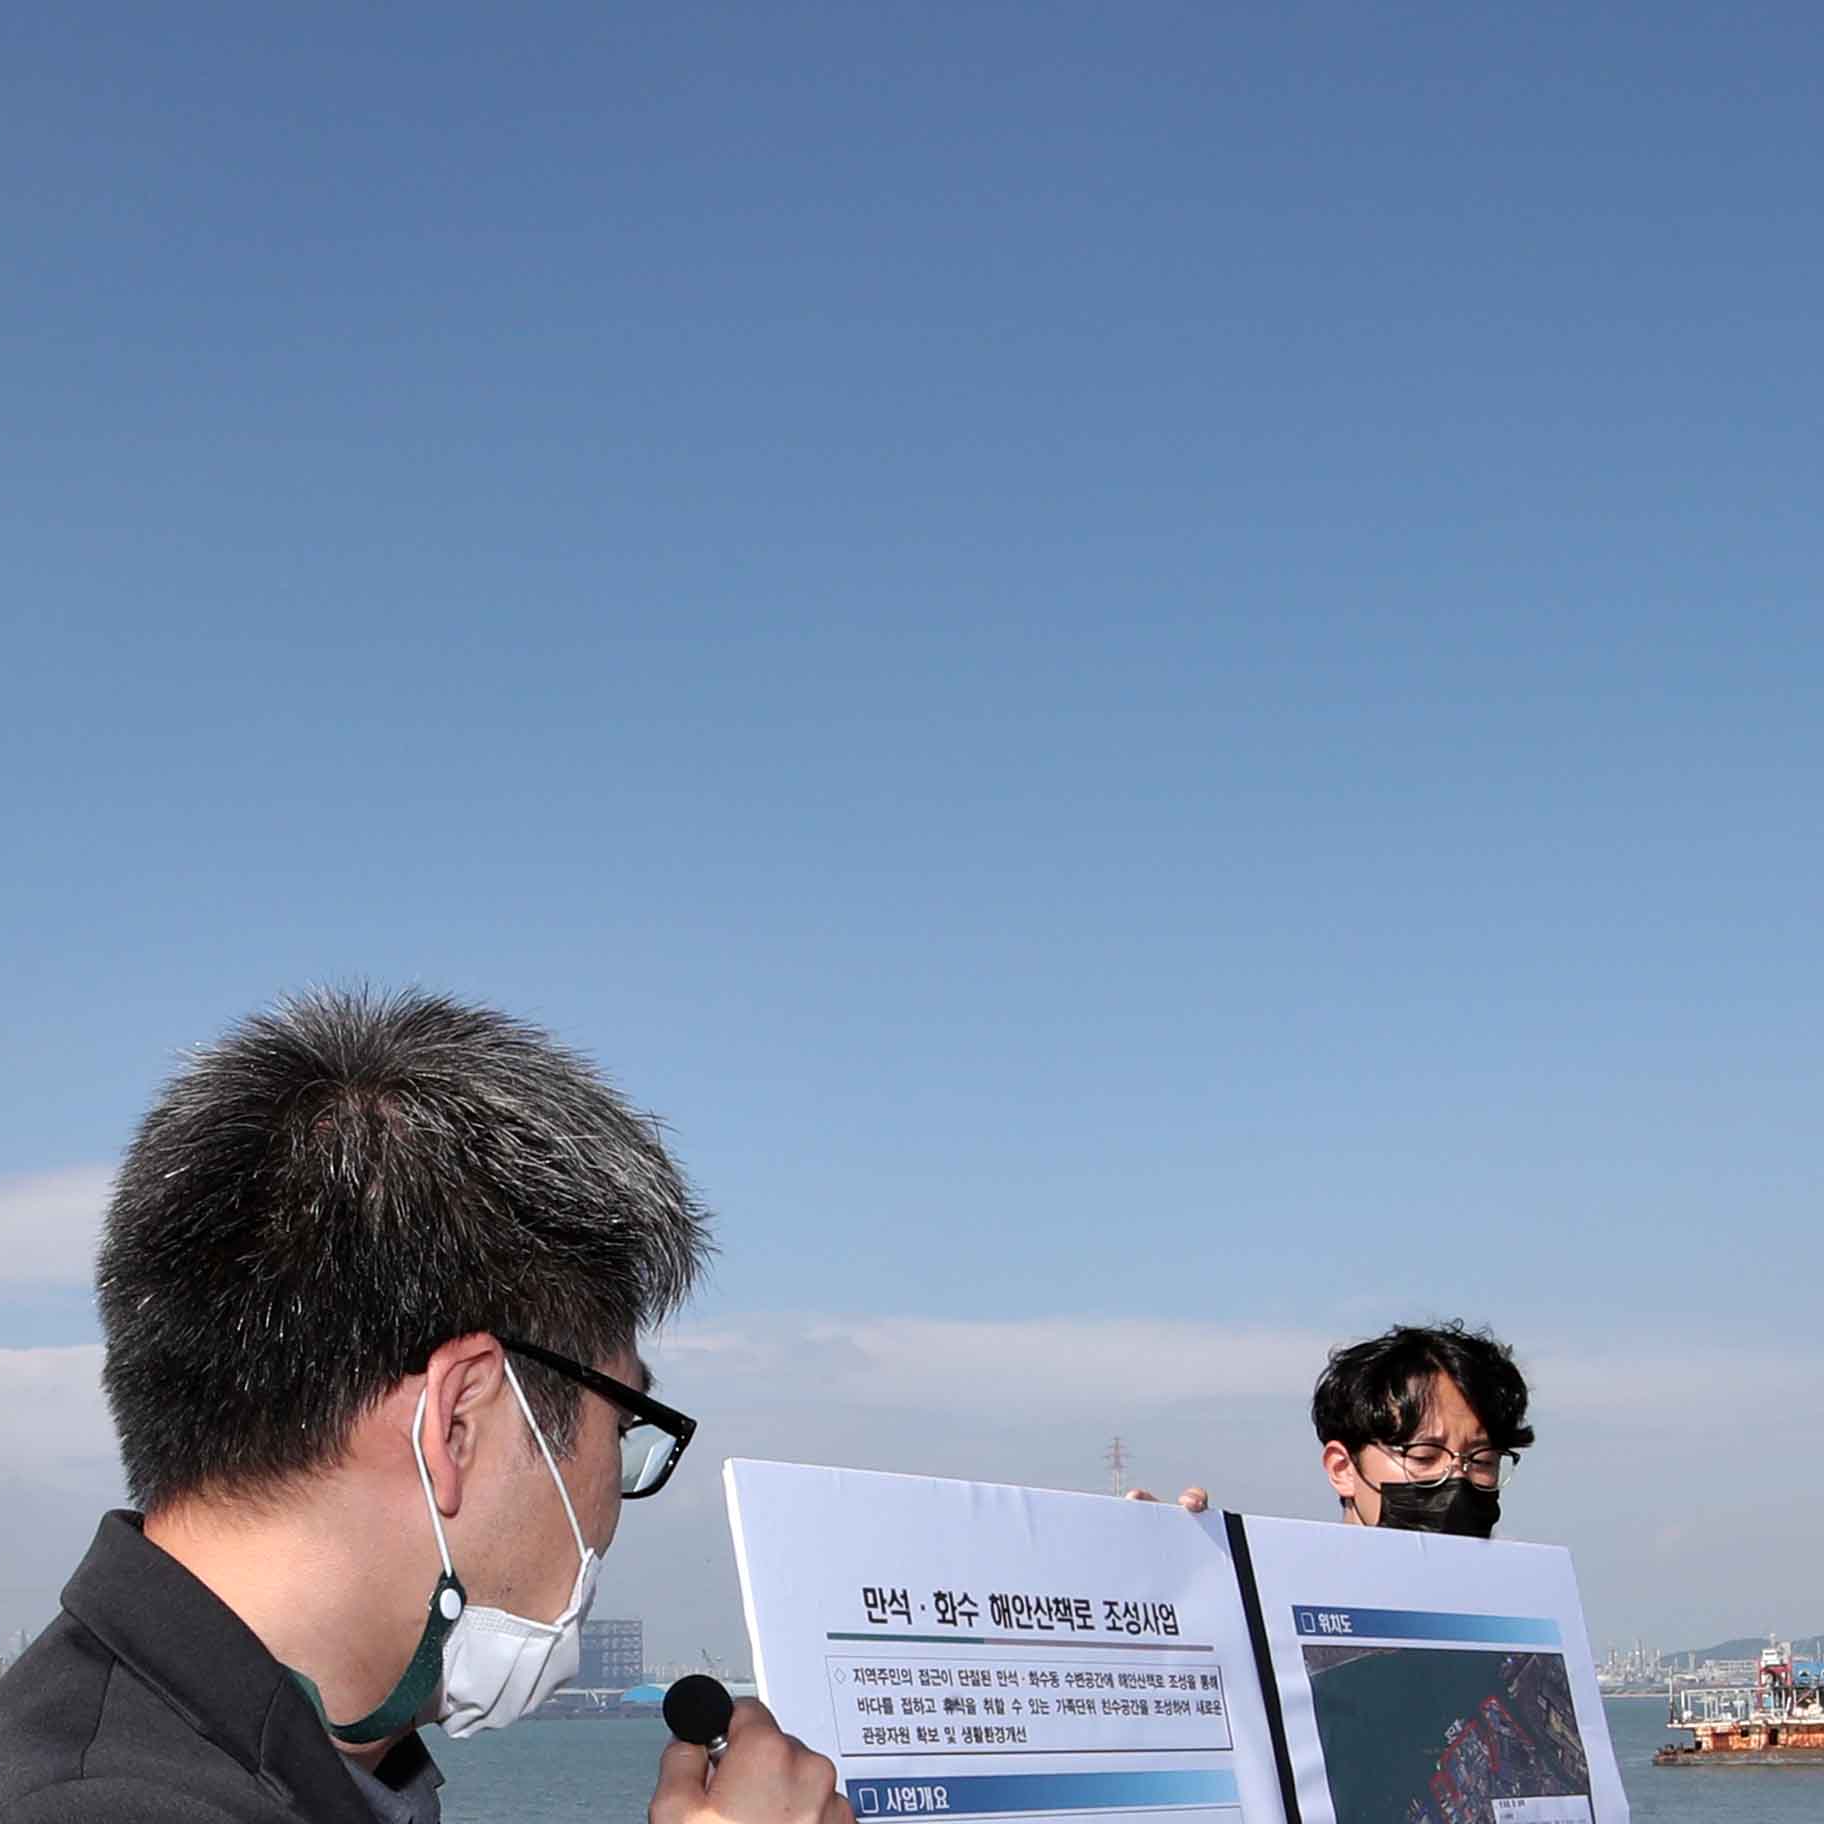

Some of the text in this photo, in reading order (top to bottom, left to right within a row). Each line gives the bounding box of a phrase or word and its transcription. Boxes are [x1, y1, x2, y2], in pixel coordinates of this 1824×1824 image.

[863, 1588, 912, 1625] 만석
[933, 1590, 979, 1627] 화수
[988, 1593, 1095, 1632] 해안산책로
[1103, 1600, 1180, 1636] 조성사업
[1318, 1613, 1353, 1633] 위치도
[853, 1668, 913, 1686] 지역주민의
[918, 1669, 953, 1686] 접근이
[958, 1670, 992, 1687] 단절된
[1168, 1674, 1196, 1690] 조성을
[857, 1697, 893, 1715] 바다를
[901, 1697, 936, 1715] 접하고
[944, 1698, 976, 1715] 휴식을
[983, 1698, 1005, 1715] 취할
[1012, 1698, 1023, 1715] 수
[1029, 1698, 1050, 1715] 있는
[1056, 1699, 1096, 1716] 가족단위
[862, 1726, 1027, 1745] 관광자원 확보 및 생활환경개선
[886, 1785, 950, 1813] 사업개요
